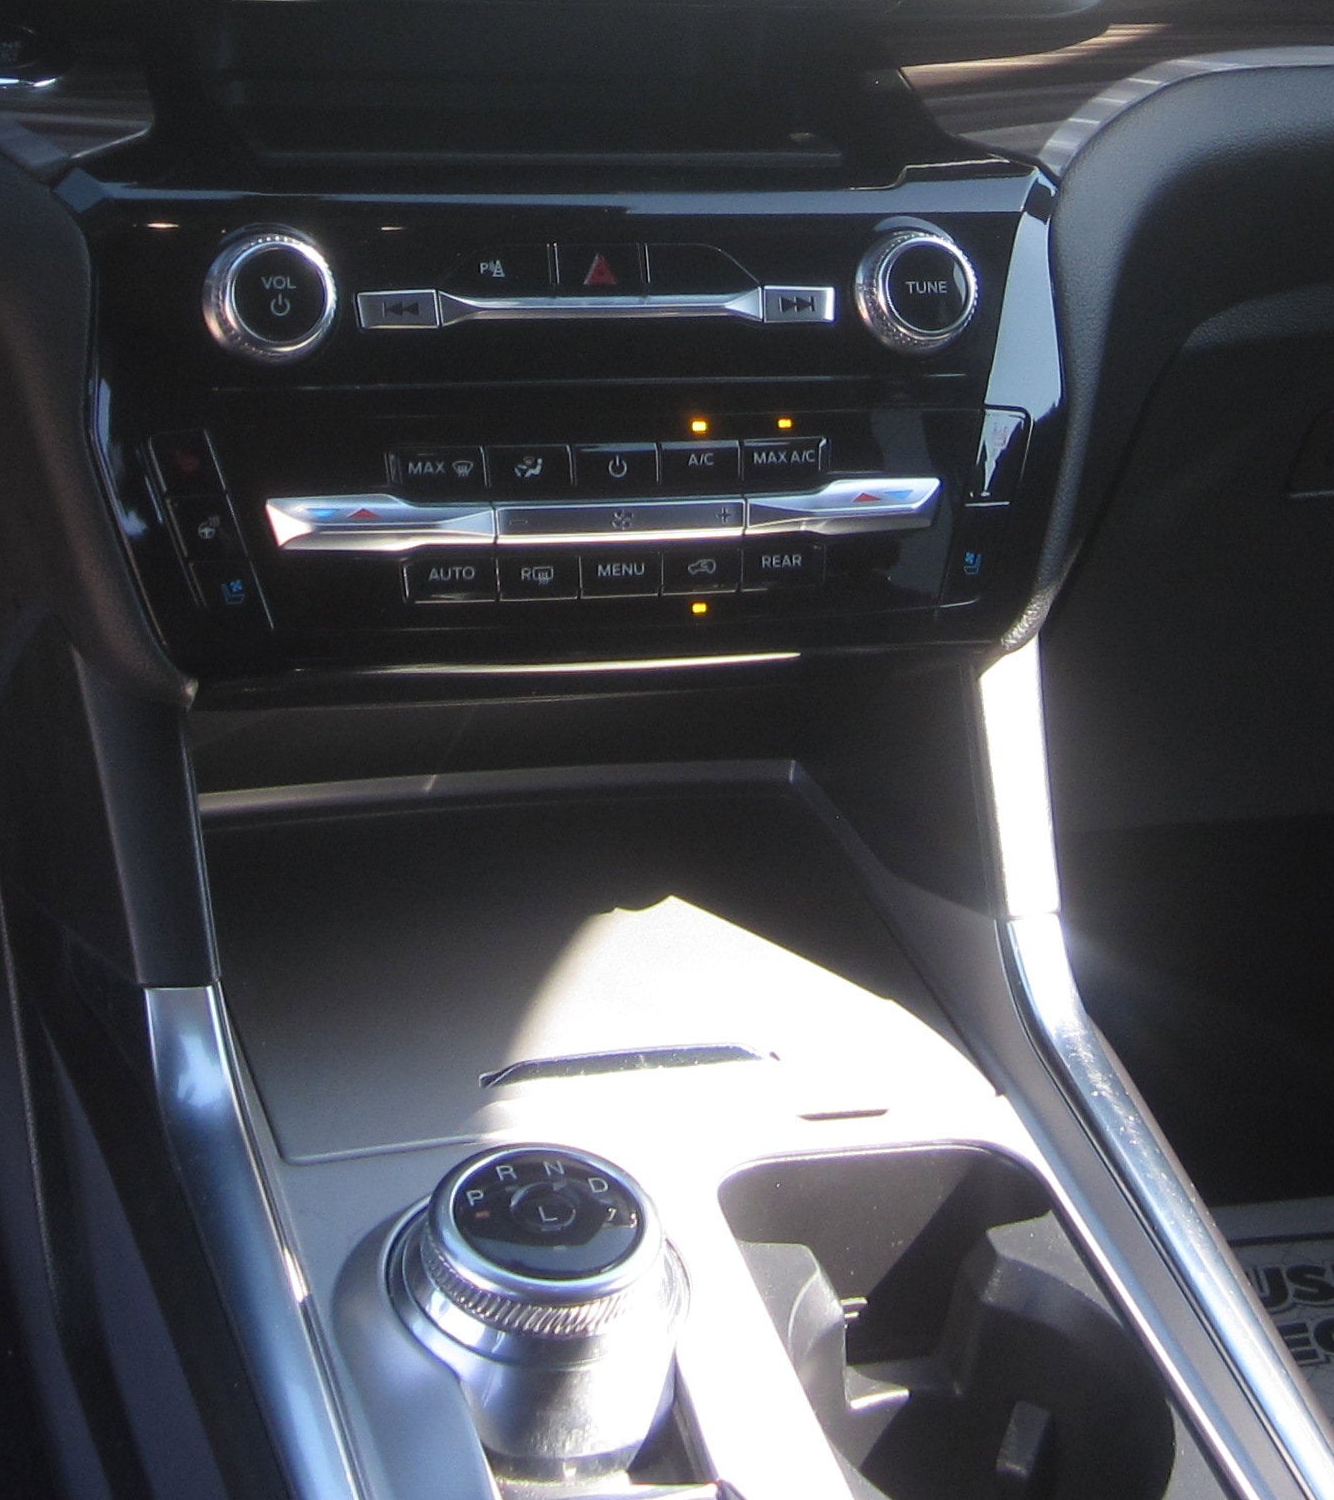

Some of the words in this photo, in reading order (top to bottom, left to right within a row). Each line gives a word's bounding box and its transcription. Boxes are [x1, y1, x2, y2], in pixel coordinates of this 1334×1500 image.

[261, 276, 296, 290] VOL
[905, 280, 948, 295] TUNE
[688, 452, 715, 467] A/C
[753, 450, 788, 465] MAX
[789, 449, 816, 464] A/C
[408, 461, 446, 476] MAX
[761, 554, 803, 569] REAR
[428, 566, 475, 582] AUTO
[597, 563, 646, 578] MENU
[467, 1189, 484, 1206] P
[496, 1165, 517, 1181] R
[542, 1160, 565, 1177] N
[588, 1177, 609, 1193] D
[538, 1206, 558, 1222] L
